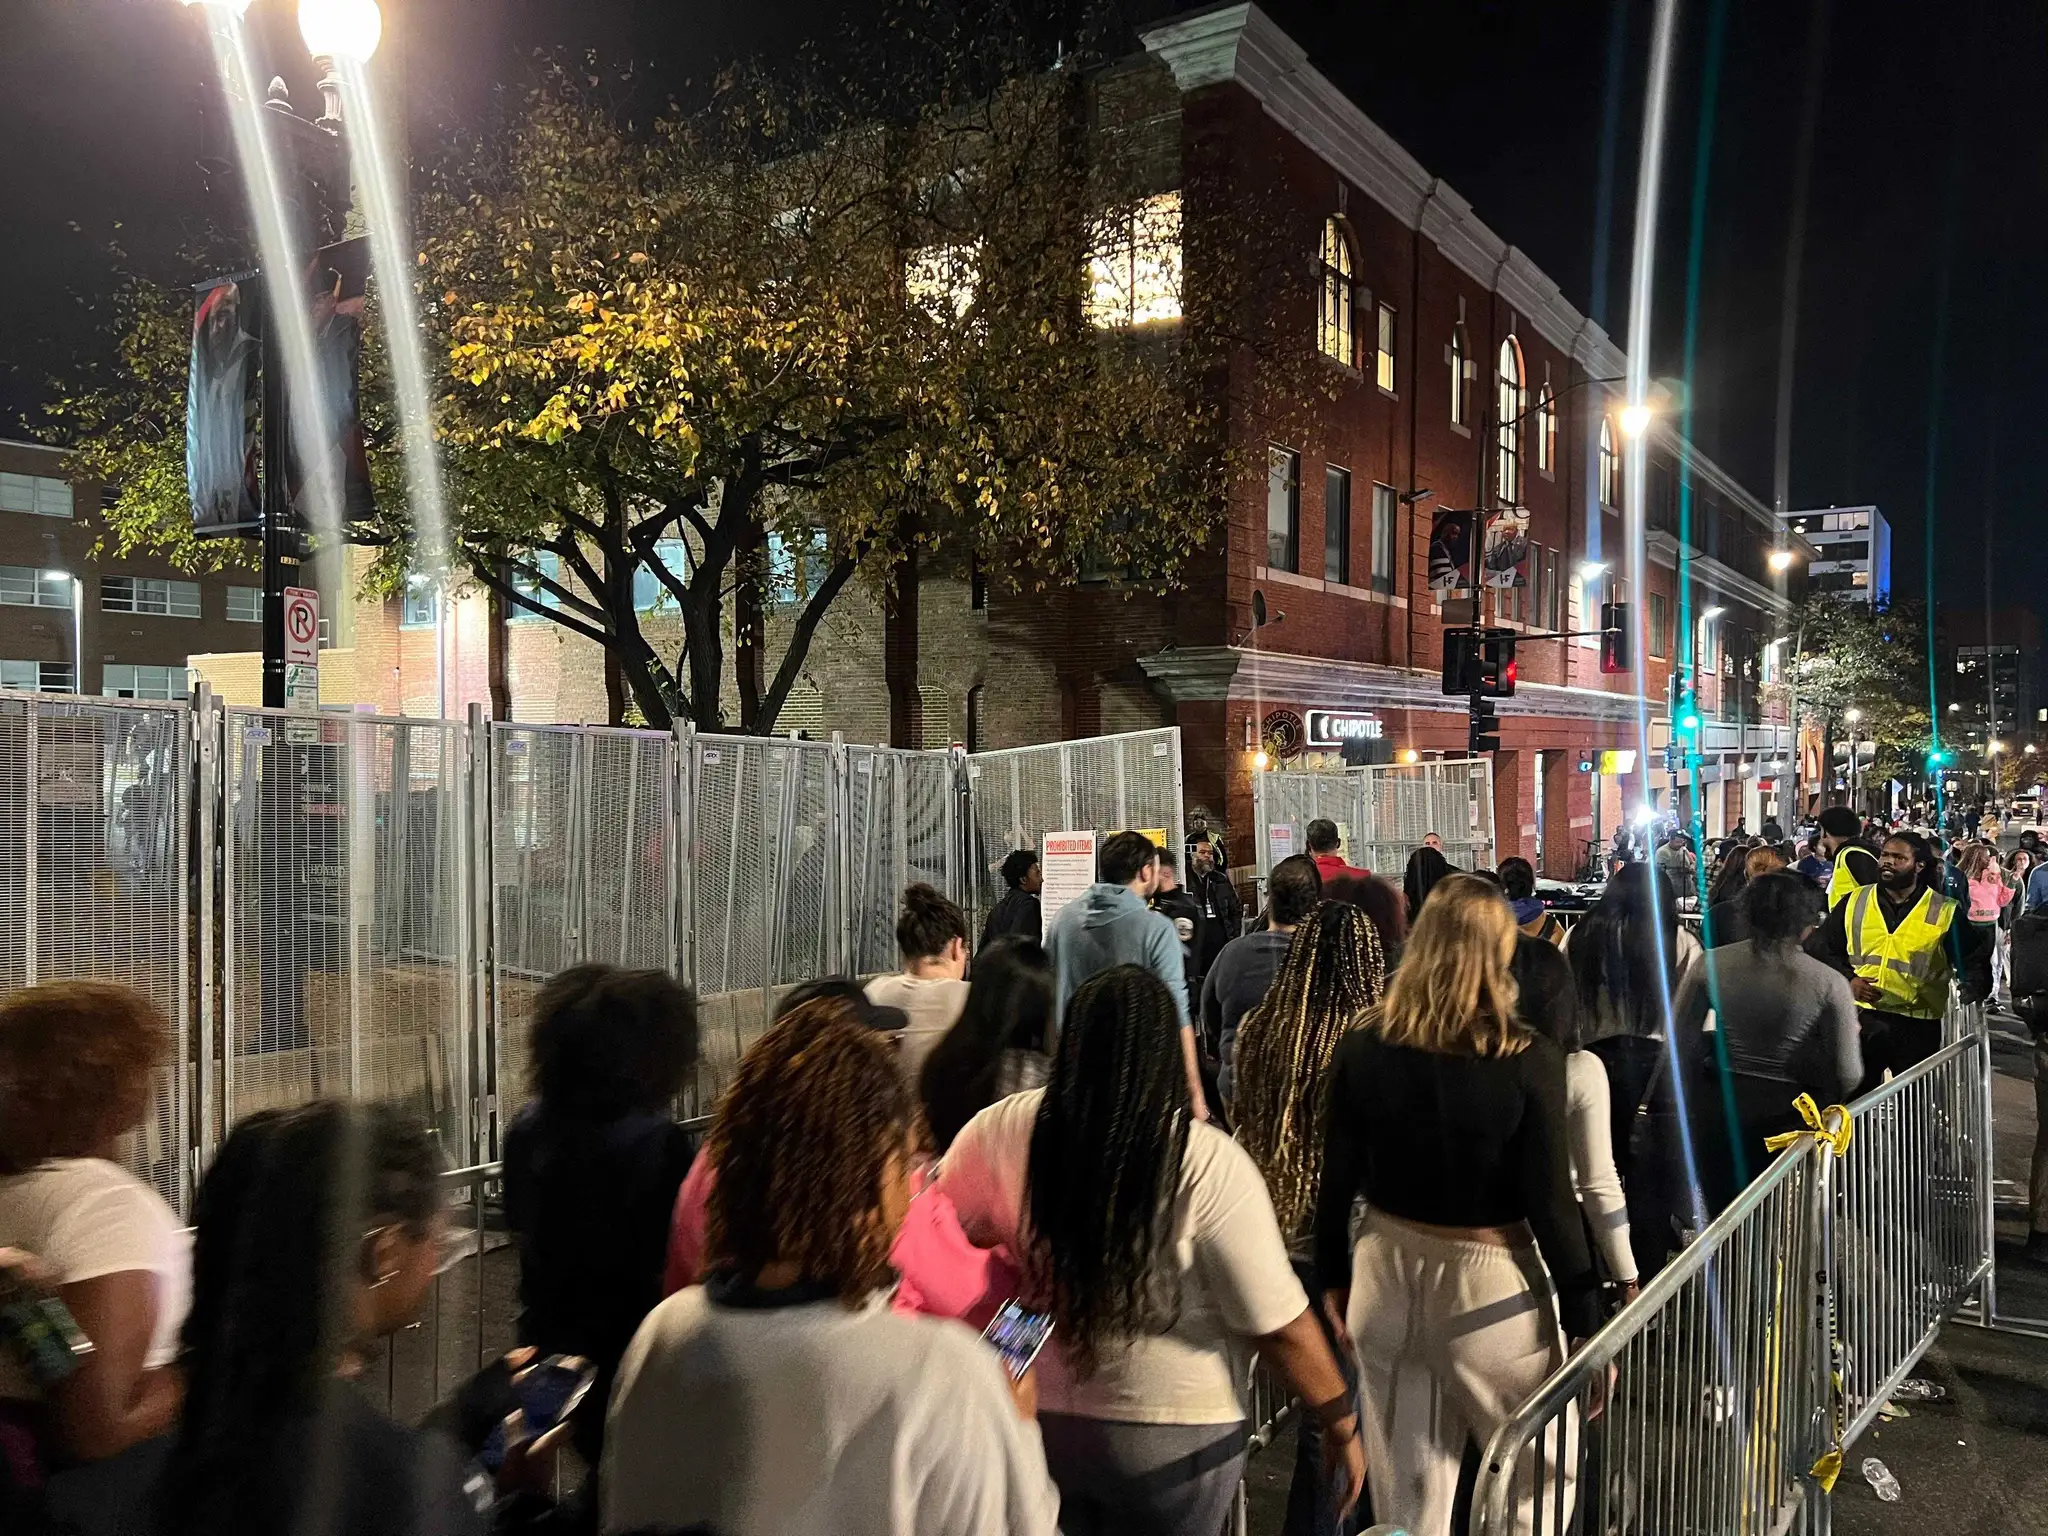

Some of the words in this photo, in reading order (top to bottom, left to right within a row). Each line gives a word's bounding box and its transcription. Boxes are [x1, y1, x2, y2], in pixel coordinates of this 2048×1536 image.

[1262, 711, 1302, 731] CHIPOTLE
[1331, 719, 1383, 738] CHIPOTLE
[246, 730, 269, 738] ARX
[1046, 840, 1076, 851] PROHIBITED
[1077, 840, 1092, 851] ITEMS
